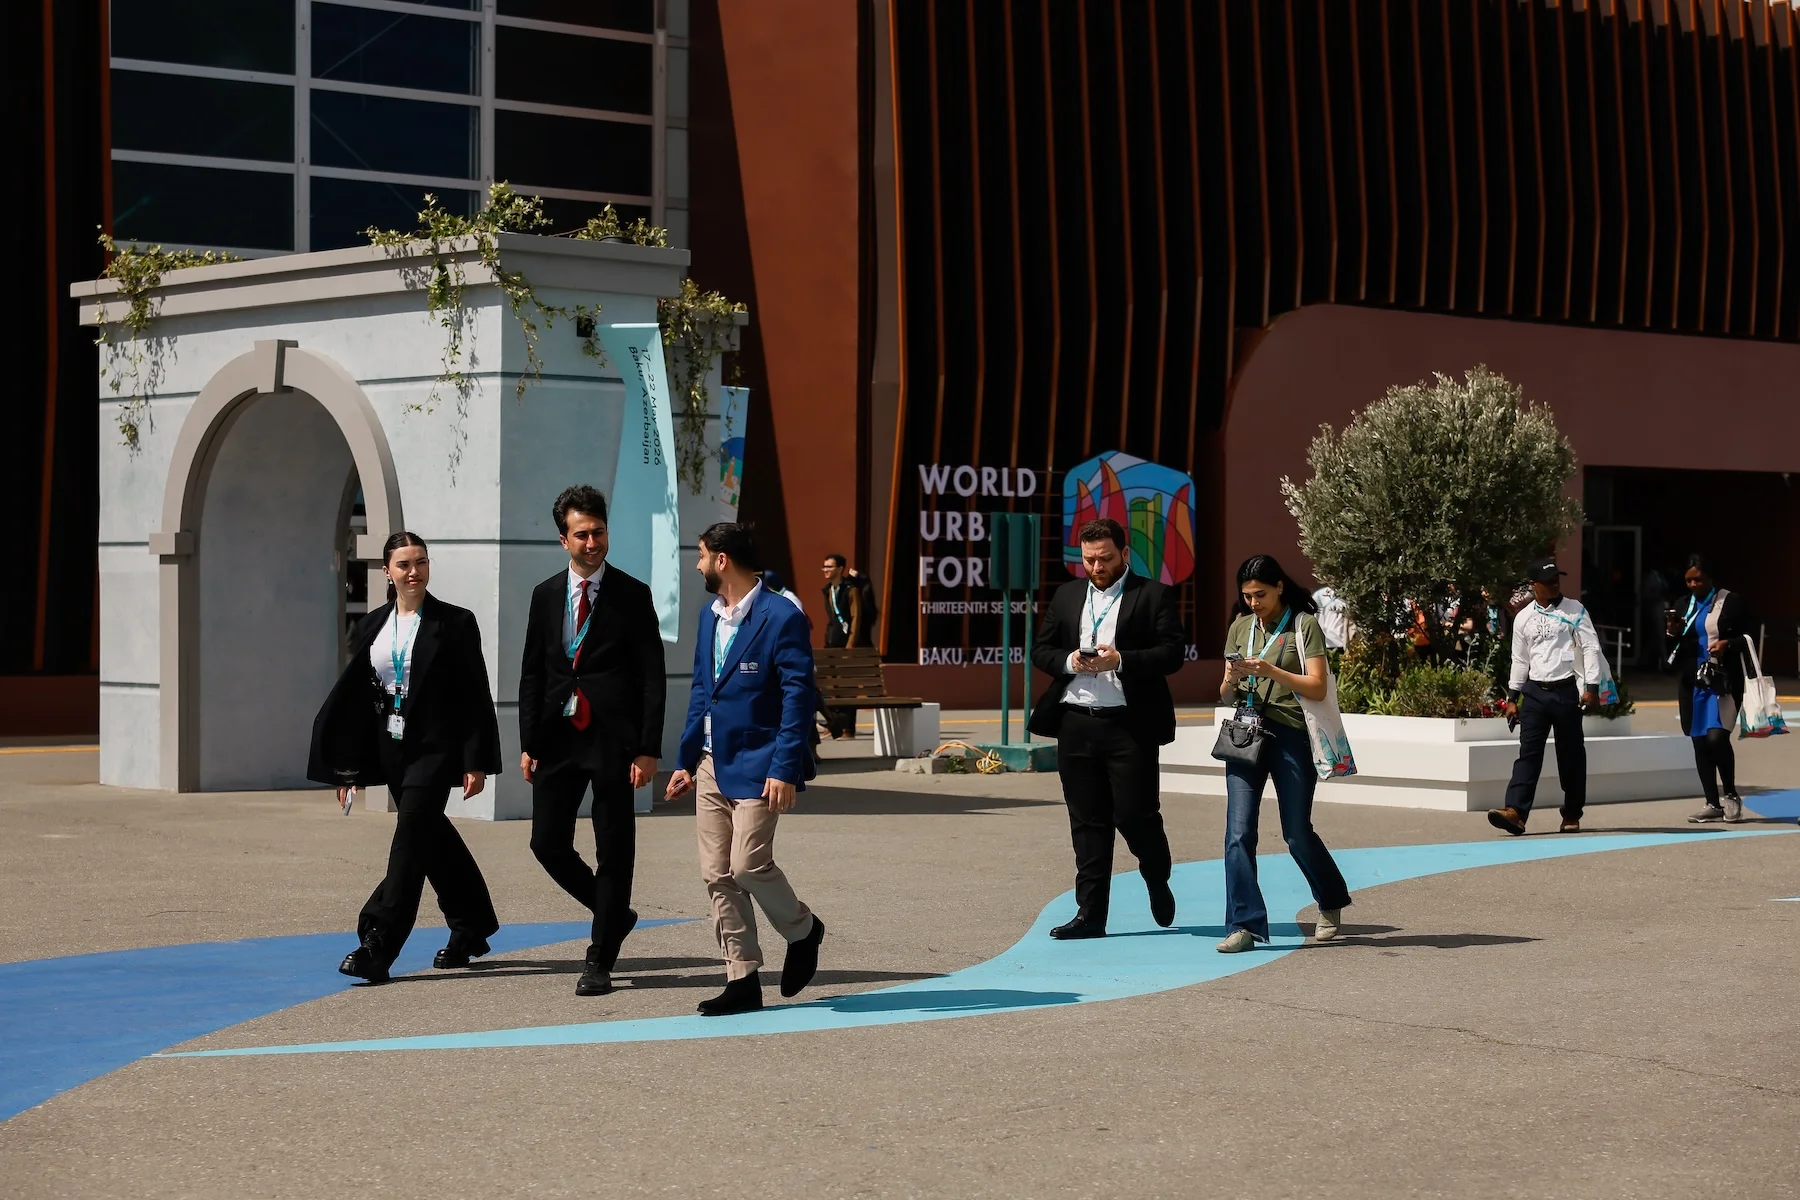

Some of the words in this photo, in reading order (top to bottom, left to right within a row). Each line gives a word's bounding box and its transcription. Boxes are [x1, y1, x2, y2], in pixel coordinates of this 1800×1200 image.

[628, 346, 644, 381] Baku,
[641, 387, 651, 465] Azerbaijan
[650, 396, 658, 424] May
[653, 430, 661, 466] 2026
[918, 463, 1037, 497] WORLD
[920, 511, 992, 542] URB
[919, 556, 991, 588] FOR
[920, 601, 988, 615] THIRTEENTH
[991, 601, 1039, 614] SESION
[919, 647, 968, 668] BAKU,
[973, 647, 1032, 665] AZERB
